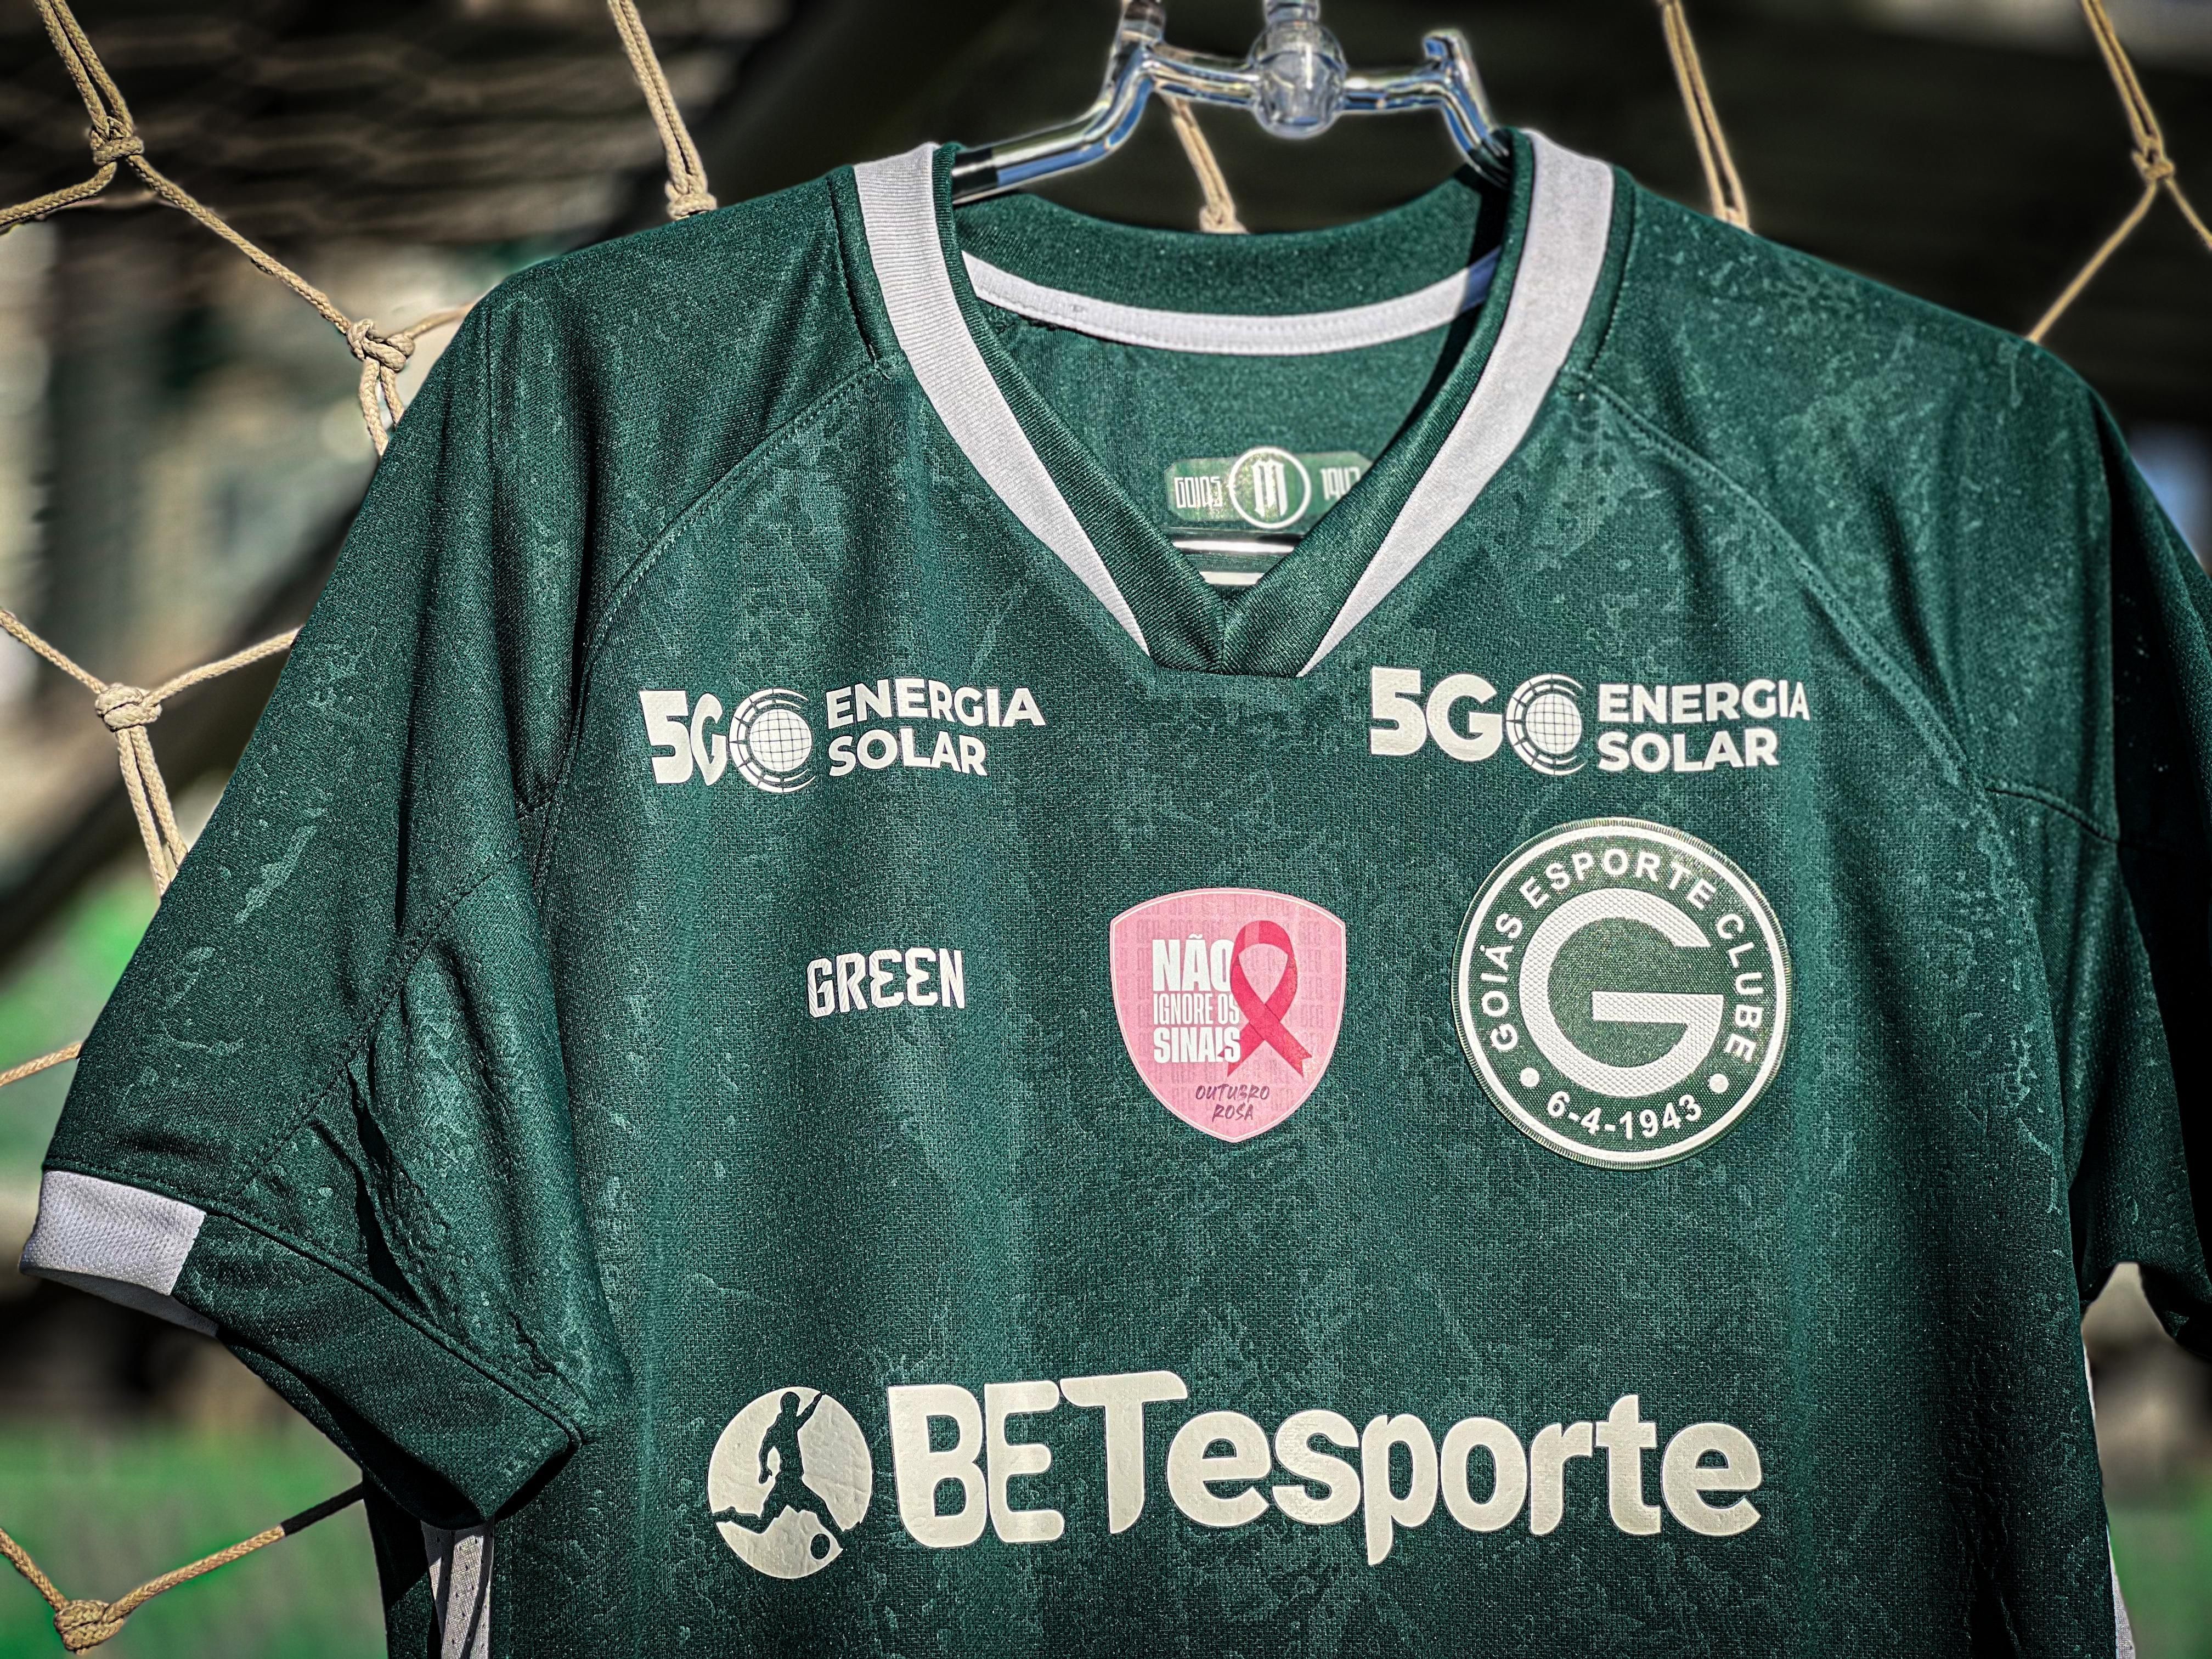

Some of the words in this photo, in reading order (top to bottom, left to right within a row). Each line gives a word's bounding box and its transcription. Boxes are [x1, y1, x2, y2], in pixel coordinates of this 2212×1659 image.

[826, 678, 1046, 729] ENERGIA
[1598, 679, 1810, 723] ENERGIA
[827, 727, 988, 777] SOLAR
[1598, 728, 1779, 772] SOLAR
[1152, 933, 1234, 992] NÃO
[1519, 848, 1717, 910] ESPORTE
[1716, 913, 1764, 1063] CLUBE
[806, 947, 966, 1018] GREEN
[1519, 887, 1724, 1097] G
[1153, 993, 1214, 1025] IGNORE
[1217, 994, 1240, 1025] OS
[1153, 1026, 1241, 1063] SINAIS
[1195, 1084, 1270, 1103] OUTUBRO
[1212, 1103, 1254, 1122] ROSA
[1547, 1091, 1701, 1139] 6-4-1943
[888, 1370, 1763, 1565] BETesporte
